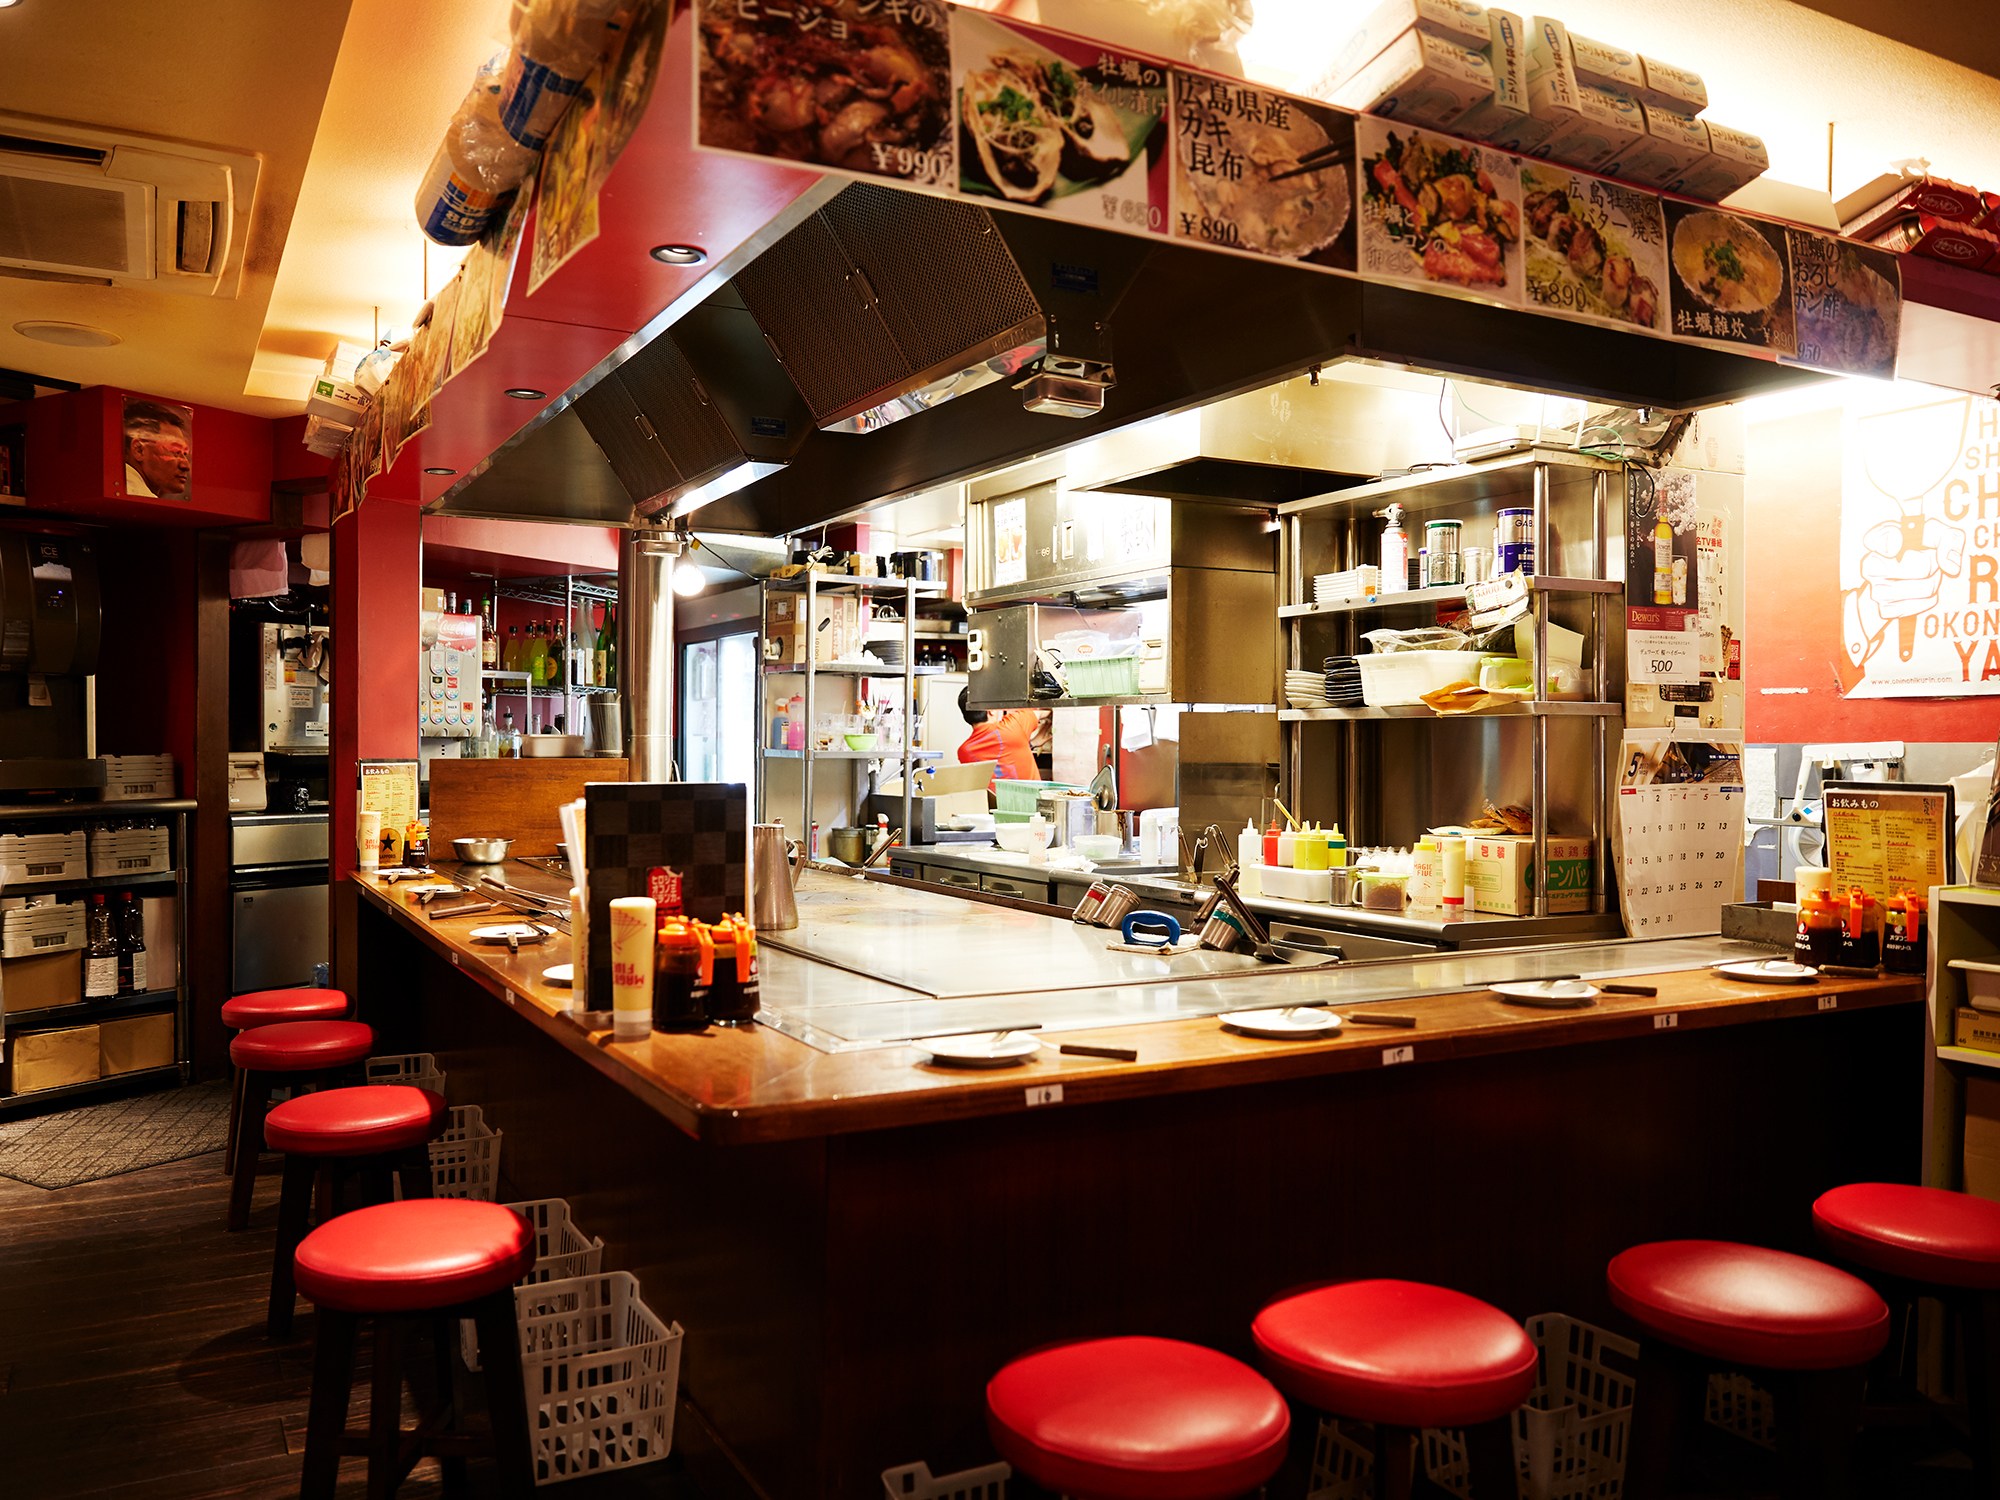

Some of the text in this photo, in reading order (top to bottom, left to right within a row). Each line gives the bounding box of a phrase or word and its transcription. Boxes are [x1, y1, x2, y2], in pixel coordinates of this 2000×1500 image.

[1177, 74, 1291, 131] 広島県産
[1180, 107, 1231, 147] カキ
[870, 142, 949, 180] ¥990
[1189, 141, 1245, 182] 昆布
[1178, 211, 1238, 245] ¥890
[1794, 257, 1839, 289] おろし
[1530, 280, 1587, 309] ¥890
[1677, 308, 1748, 340] 牡蠣雑炊
[1763, 327, 1794, 350] ¥890
[41, 546, 58, 556] ICE
[1631, 610, 1660, 623] Dewar's
[1651, 659, 1673, 673] 500
[1628, 751, 1645, 777] 5
[1656, 794, 1661, 802] 2
[1703, 793, 1709, 801] 5
[1725, 793, 1730, 801] 6
[1831, 798, 1879, 809] お飲みもの
[1697, 822, 1706, 830] 12
[1718, 822, 1727, 830] 13
[1641, 856, 1648, 864] 15
[1680, 852, 1686, 860] 18
[1696, 851, 1704, 859] 19
[1715, 851, 1725, 859] 20
[1641, 887, 1648, 895] 22
[1656, 886, 1662, 894] 23
[1668, 884, 1674, 892] 24
[1680, 883, 1686, 891] 25
[1695, 881, 1703, 889] 26
[1714, 880, 1722, 888] 27
[1641, 918, 1647, 926] 29
